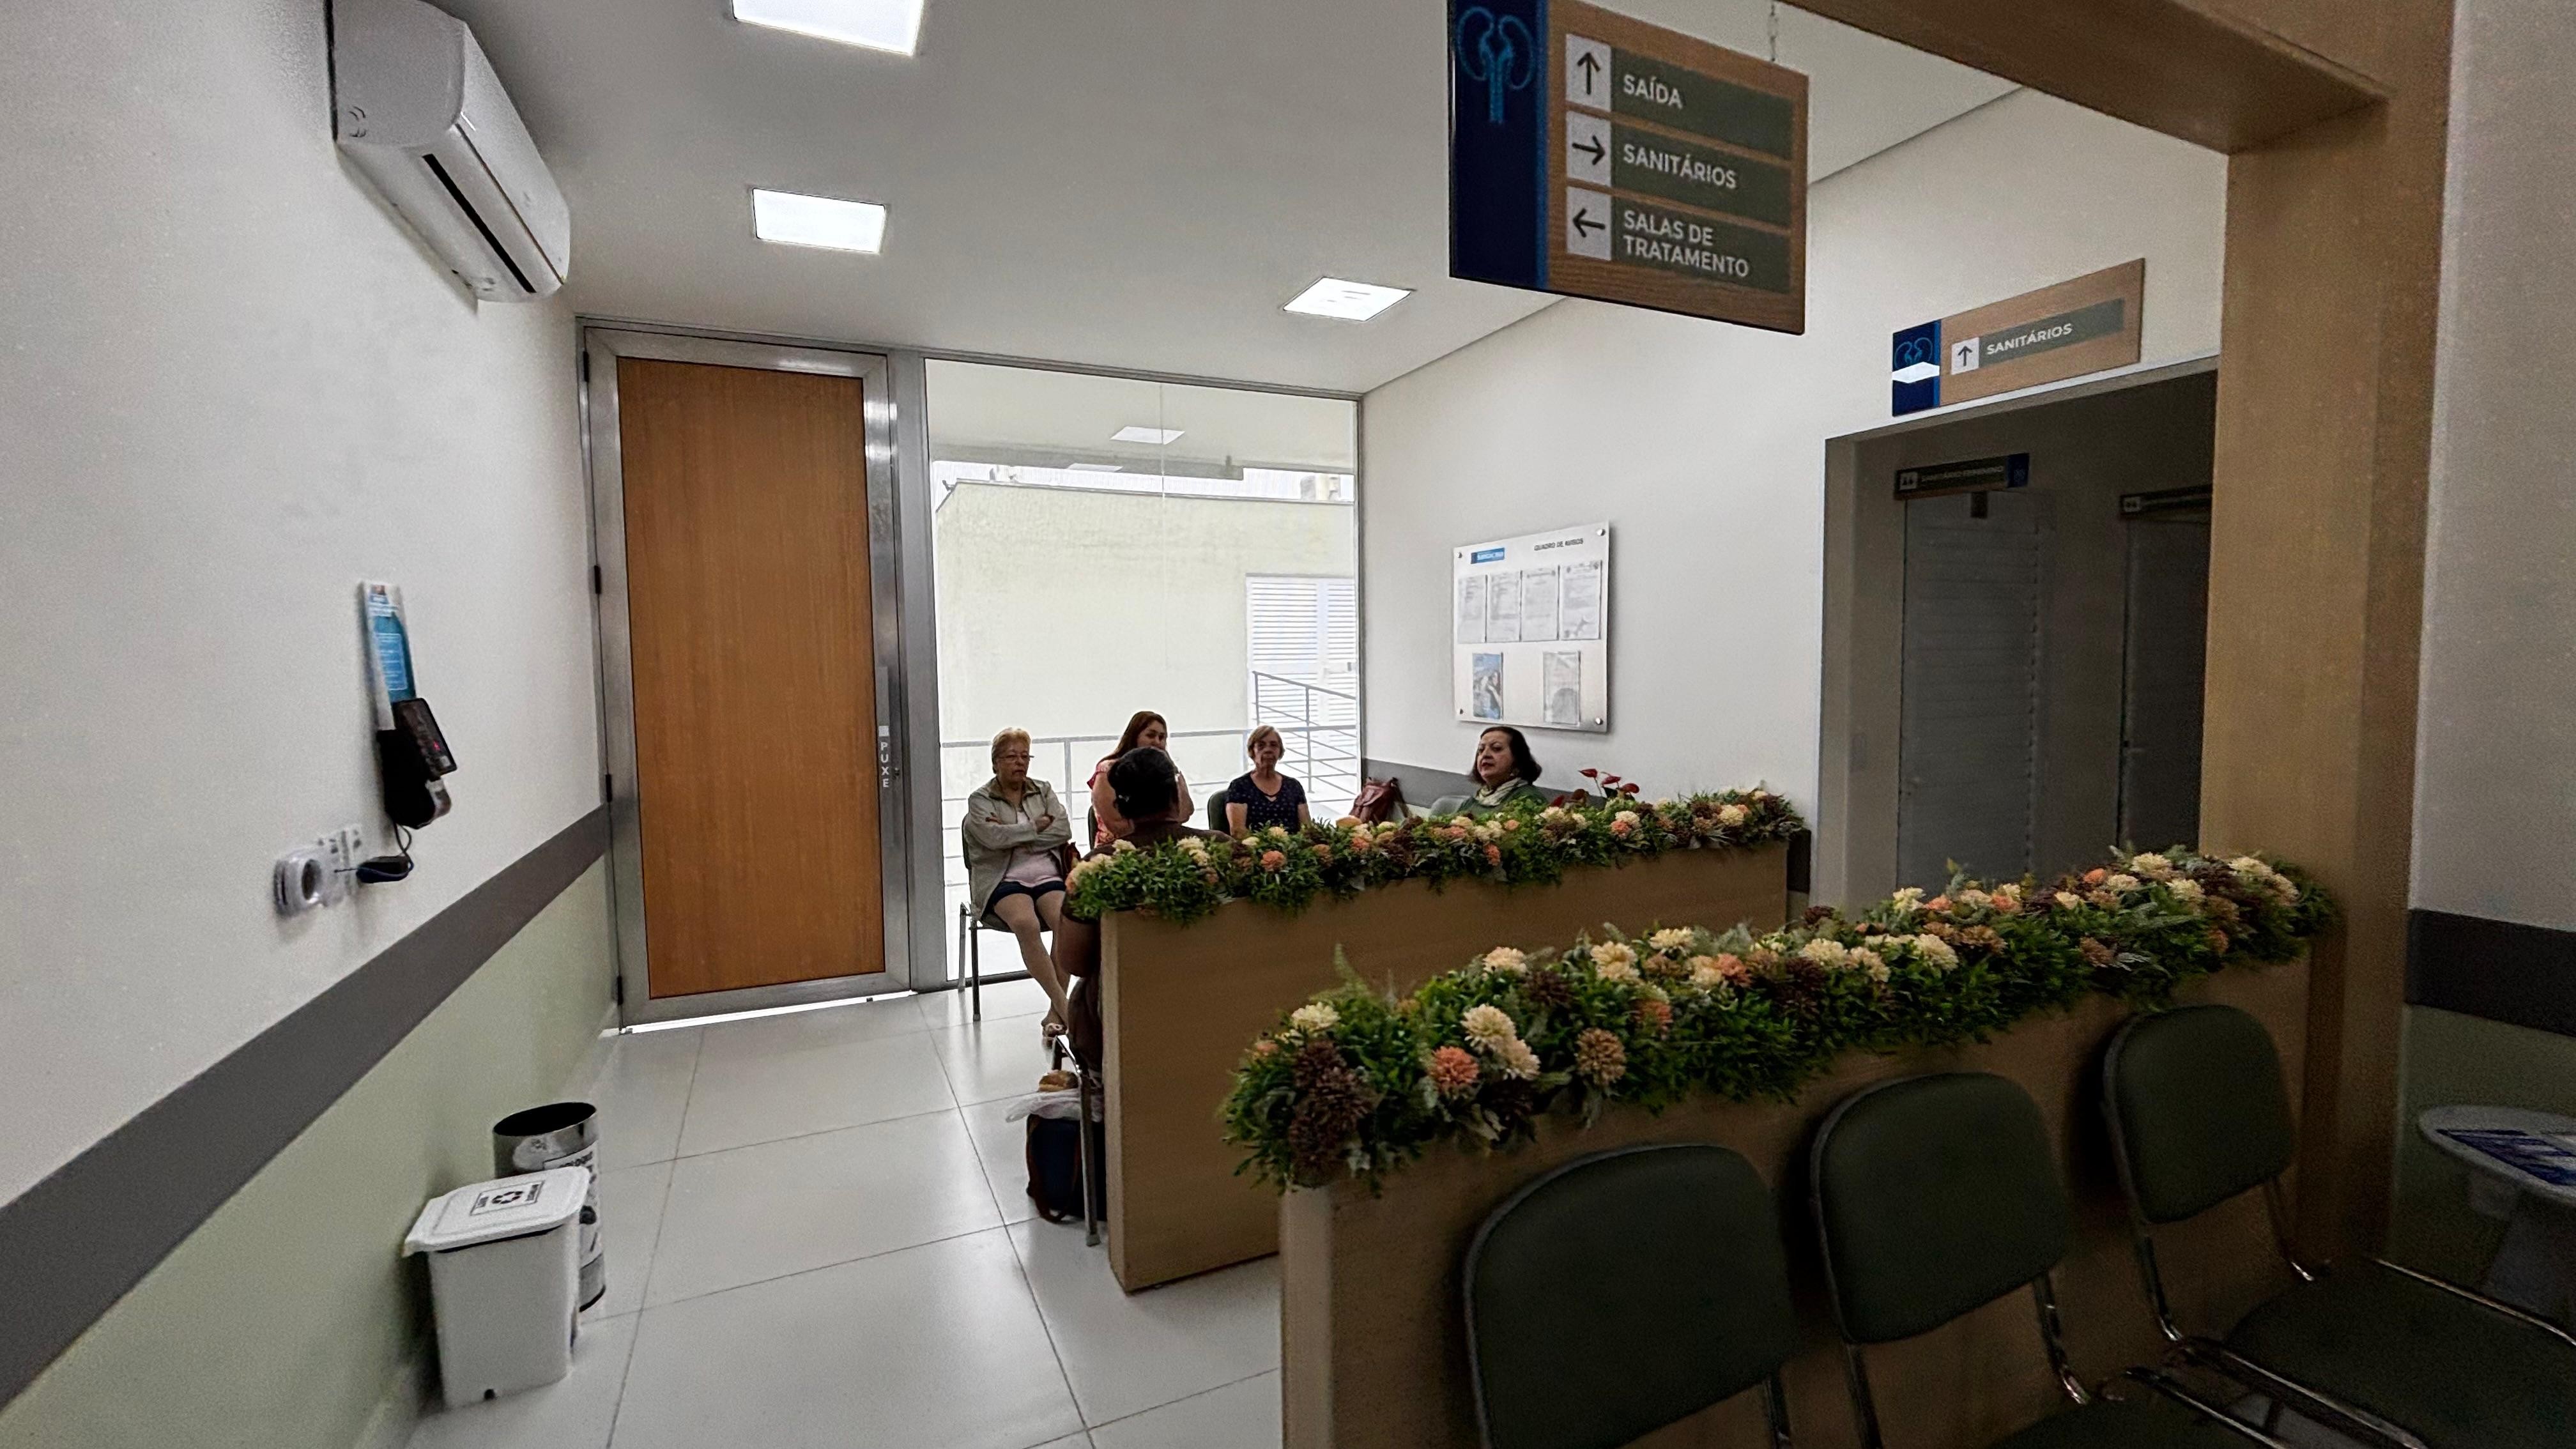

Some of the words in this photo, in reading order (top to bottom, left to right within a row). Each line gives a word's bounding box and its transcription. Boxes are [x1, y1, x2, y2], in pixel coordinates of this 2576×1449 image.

[1623, 73, 1683, 109] SAÍDA
[1623, 144, 1737, 190] SANITÁRIOS
[1623, 210, 1684, 239] SALAS
[1689, 224, 1713, 247] DE
[1623, 235, 1750, 277] TRATAMENTO
[1986, 323, 2073, 355] SANITÁRIOS
[880, 742, 889, 787] PUXE
